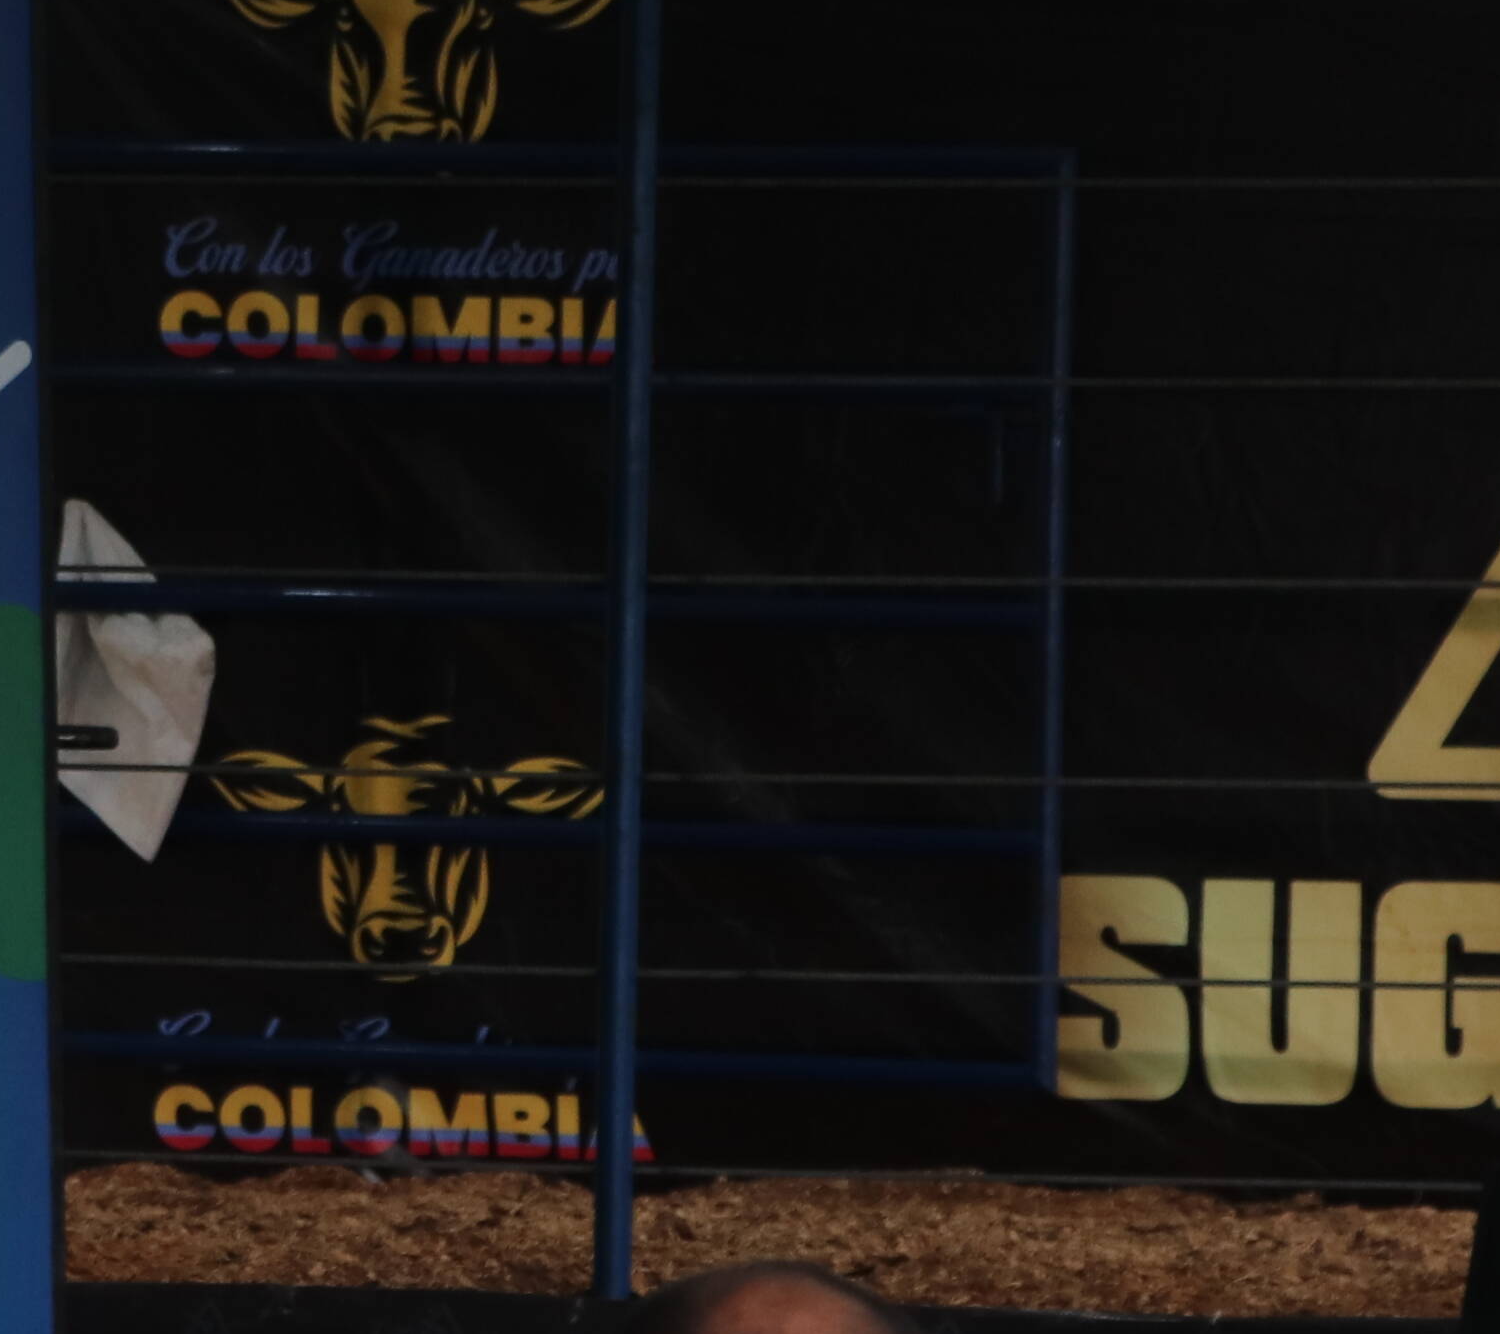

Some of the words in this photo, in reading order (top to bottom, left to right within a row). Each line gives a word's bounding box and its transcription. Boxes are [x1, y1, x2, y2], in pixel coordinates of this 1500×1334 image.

[165, 216, 248, 278] Con
[257, 225, 313, 276] los
[341, 219, 561, 291] Ganaderos
